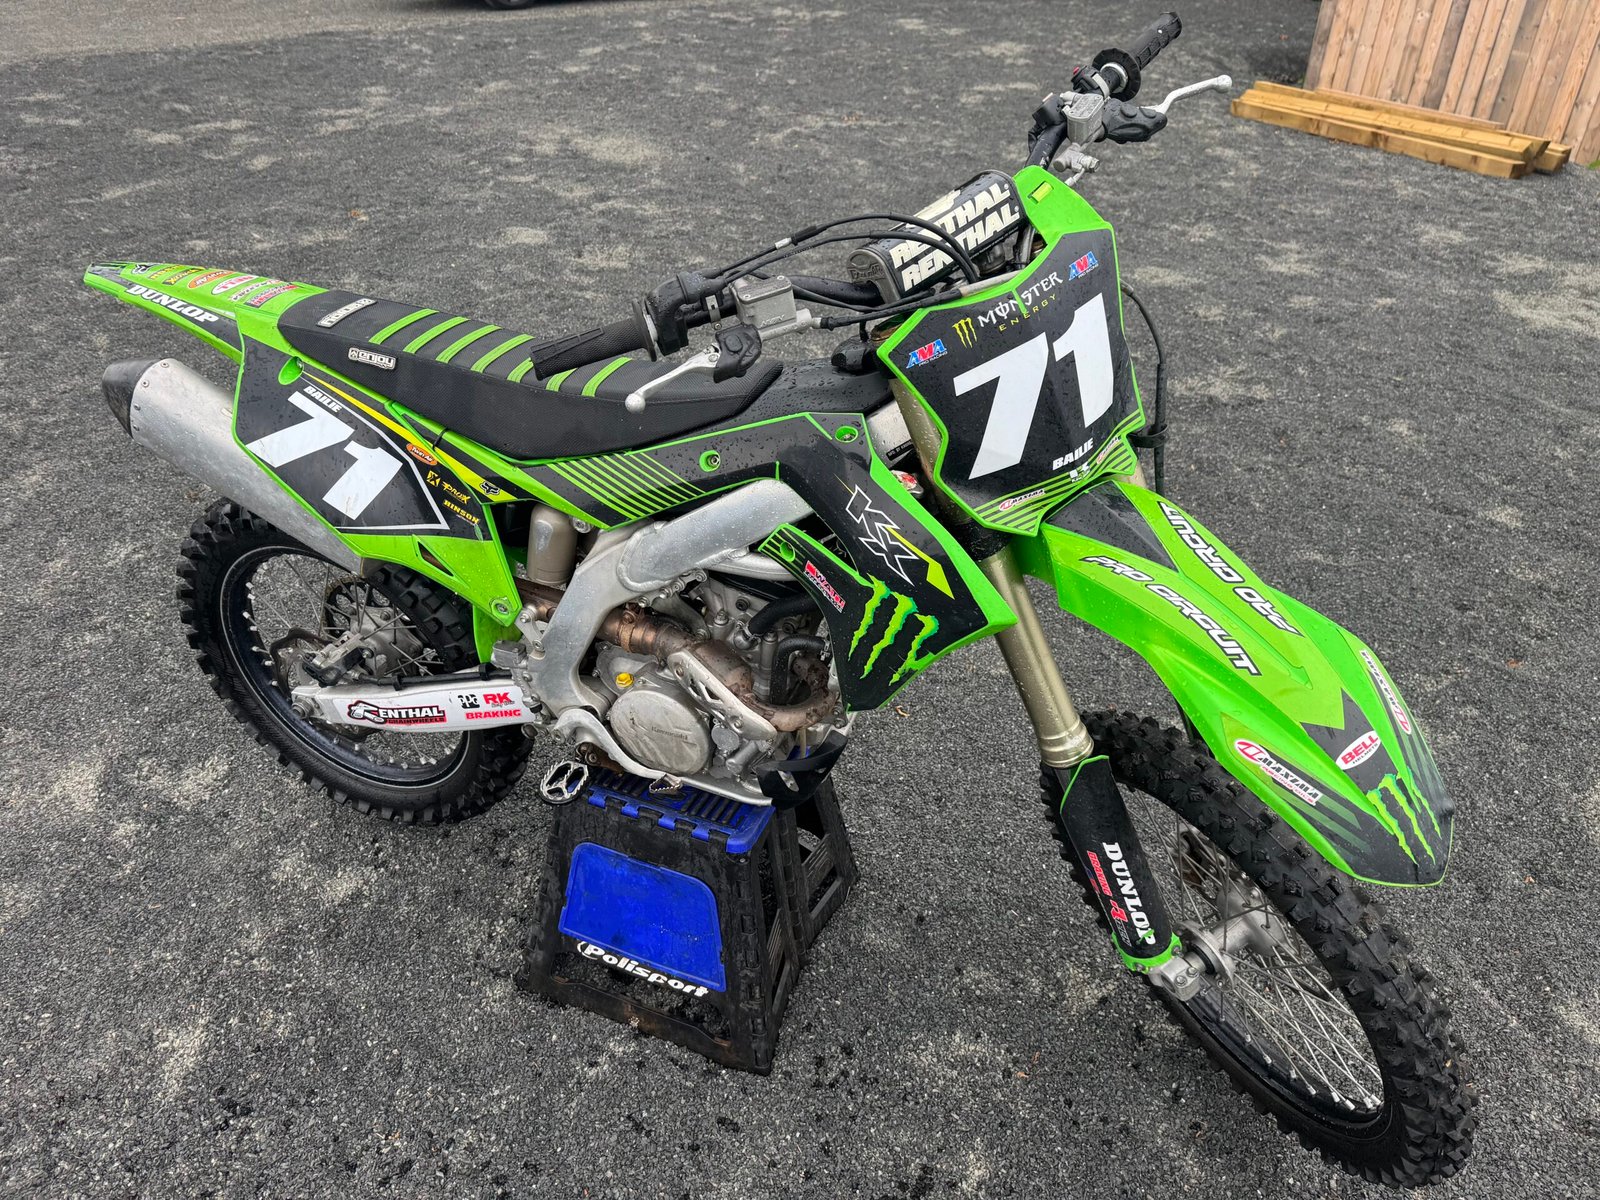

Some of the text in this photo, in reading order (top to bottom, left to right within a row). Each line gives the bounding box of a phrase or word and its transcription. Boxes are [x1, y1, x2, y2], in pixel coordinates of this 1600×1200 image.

[1068, 251, 1099, 281] AMA
[127, 284, 220, 324] DUNLOP
[999, 293, 1058, 333] ENERGY
[906, 338, 947, 369] AMA
[303, 385, 343, 413] BAILIE
[953, 292, 1114, 480] 71
[244, 391, 403, 520] 71
[1052, 437, 1094, 471] BAILIE
[443, 499, 480, 524] HINSON
[845, 484, 919, 587] KX
[1157, 500, 1305, 638] PRO CIRCUIT
[1079, 556, 1262, 676] PRO CIRCUIT
[466, 709, 522, 720] BRAKING
[483, 692, 511, 705] RK
[1341, 734, 1379, 765] BELL
[1087, 850, 1113, 897] BRAKING
[1102, 842, 1156, 945] DUNLOP
[582, 941, 709, 998] Polisport
